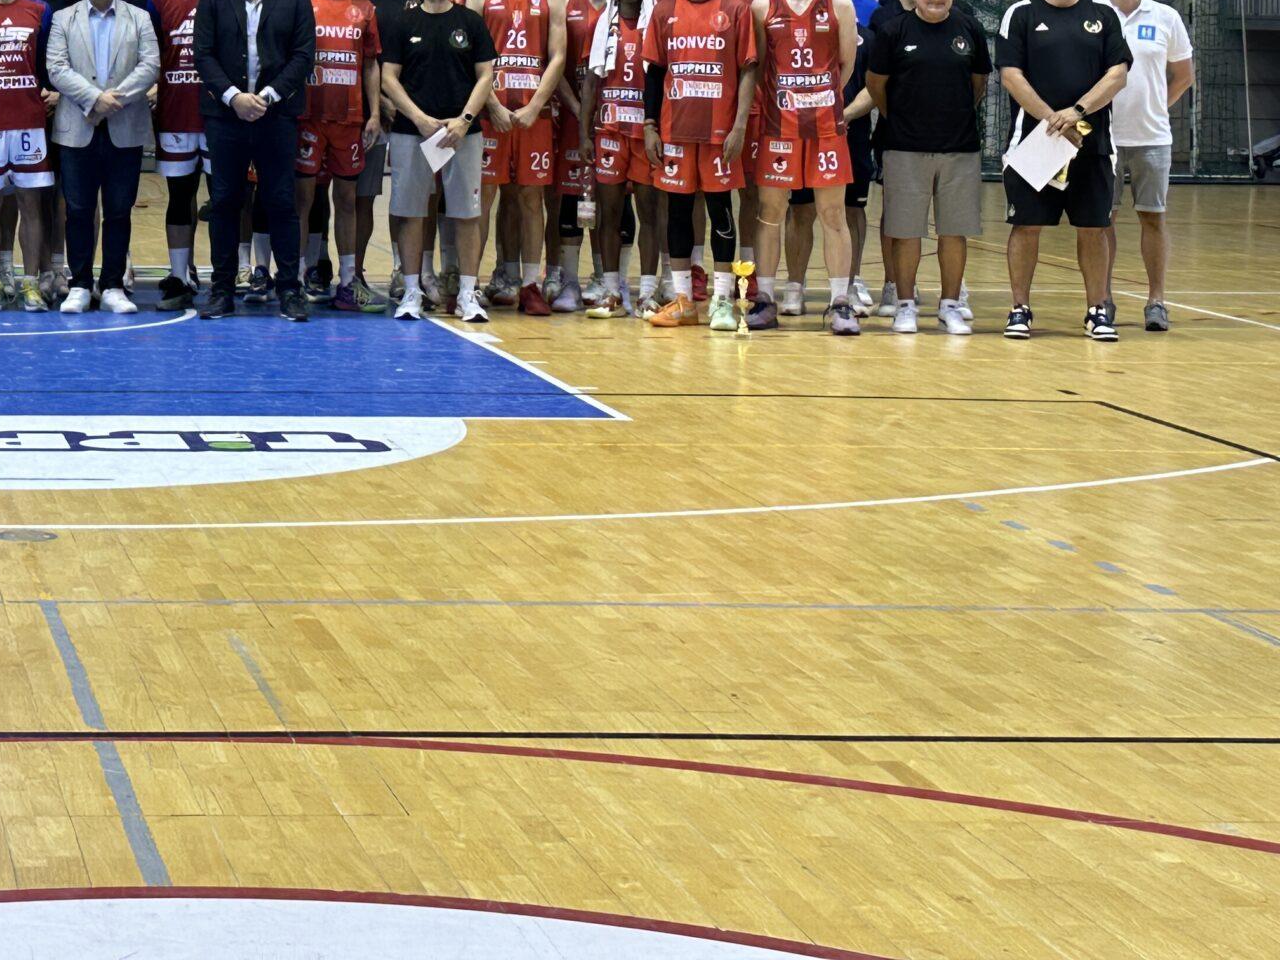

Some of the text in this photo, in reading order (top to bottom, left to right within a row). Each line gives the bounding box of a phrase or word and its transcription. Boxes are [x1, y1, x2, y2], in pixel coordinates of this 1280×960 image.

[315, 25, 361, 39] ONVÉD
[506, 30, 527, 49] 26
[668, 35, 725, 49] HONVÉD
[791, 48, 813, 68] 33
[624, 62, 634, 82] 5
[21, 132, 30, 151] 6
[751, 142, 758, 159] 2
[351, 144, 359, 162] 2
[531, 152, 550, 170] 26
[818, 151, 838, 171] 33
